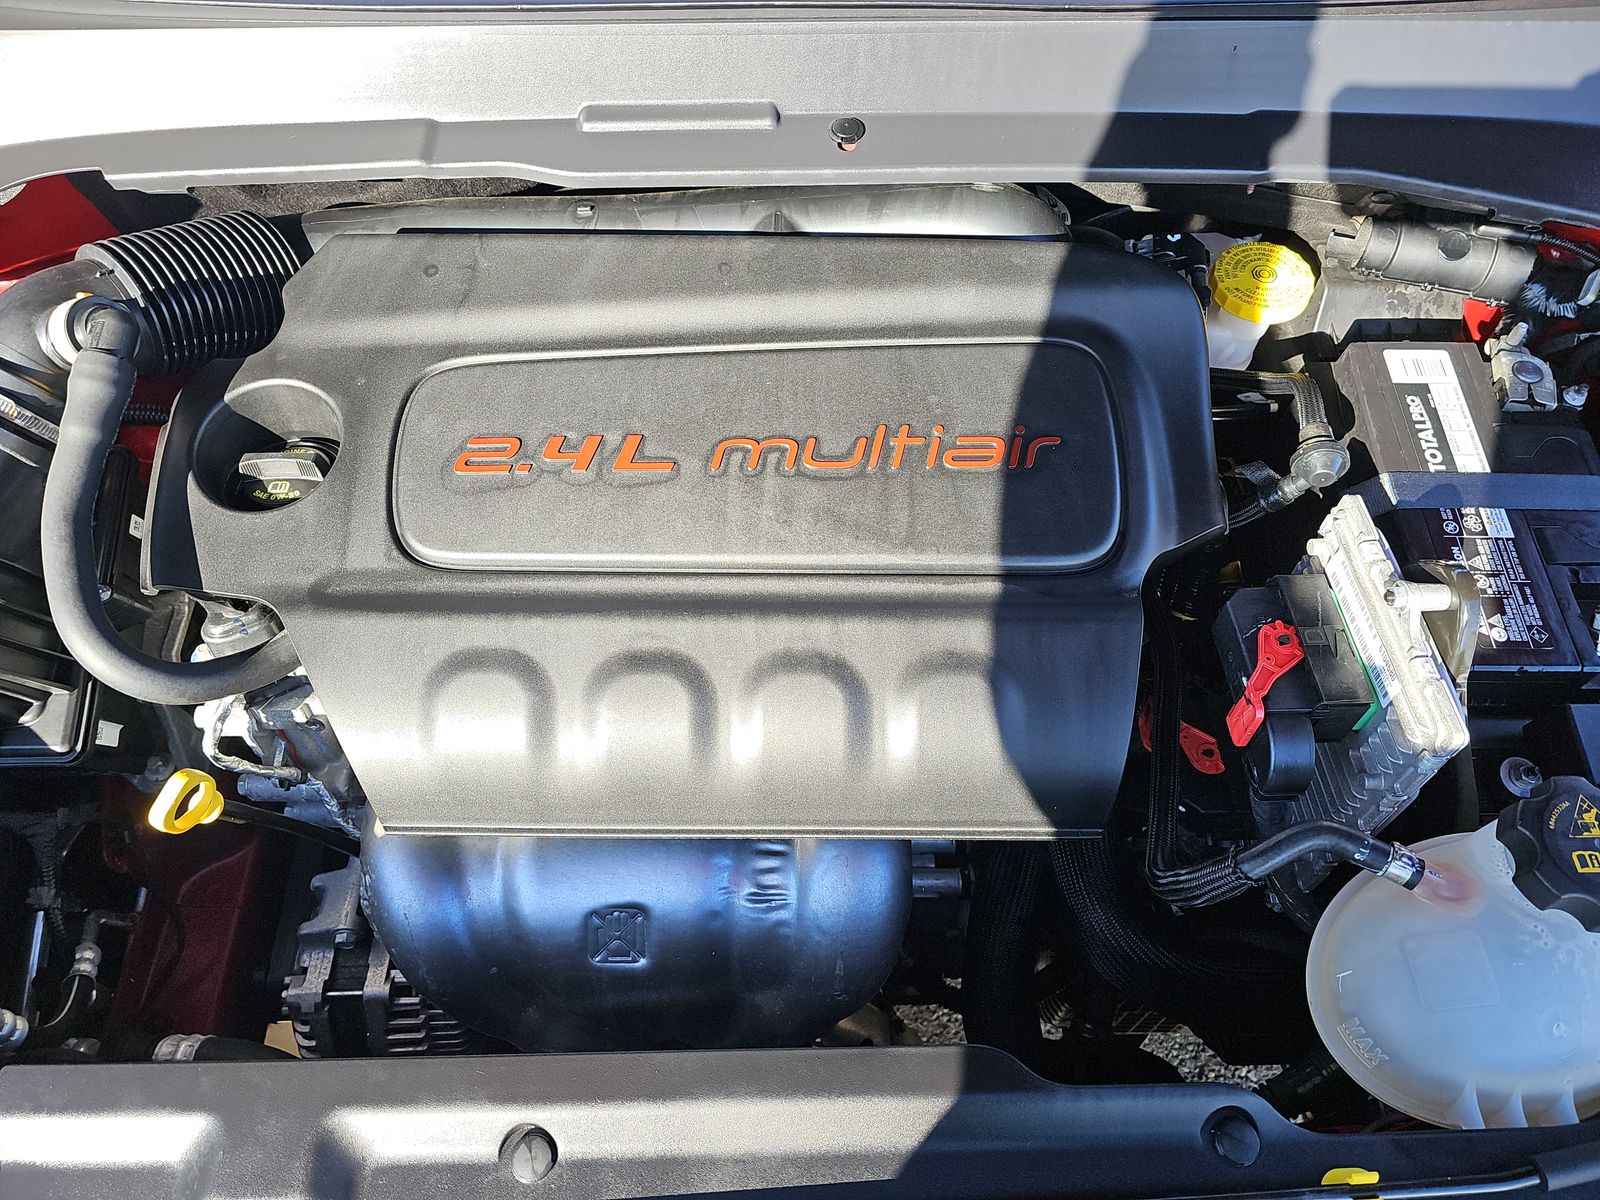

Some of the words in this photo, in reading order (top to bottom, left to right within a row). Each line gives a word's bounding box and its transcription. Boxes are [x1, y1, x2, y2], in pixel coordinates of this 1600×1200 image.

[454, 434, 676, 474] 2.4L
[710, 423, 1061, 470] multiair
[1406, 396, 1446, 472] TOTALPRO
[254, 490, 270, 499] SAE
[1342, 1016, 1390, 1066] MAX
